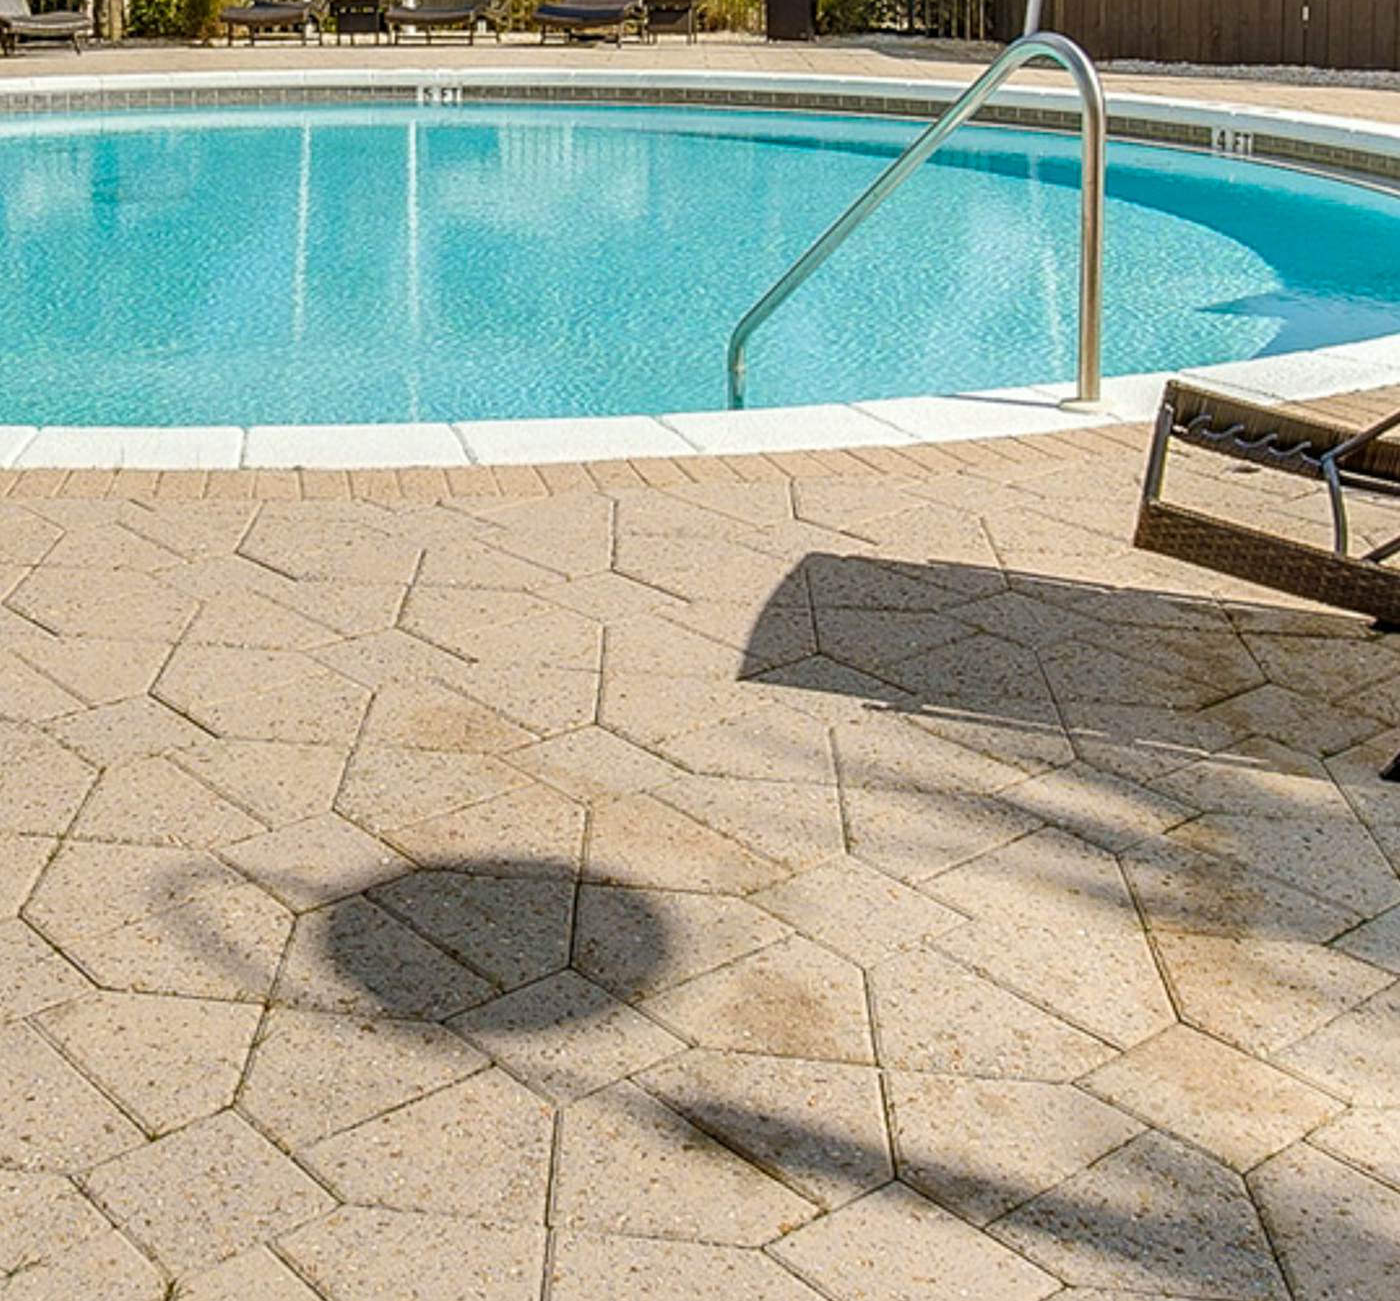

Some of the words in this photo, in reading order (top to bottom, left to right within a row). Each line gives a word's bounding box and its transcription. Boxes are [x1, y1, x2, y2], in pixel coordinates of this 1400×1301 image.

[441, 86, 459, 106] FT
[1216, 129, 1226, 151] 4
[1232, 132, 1250, 154] FT
